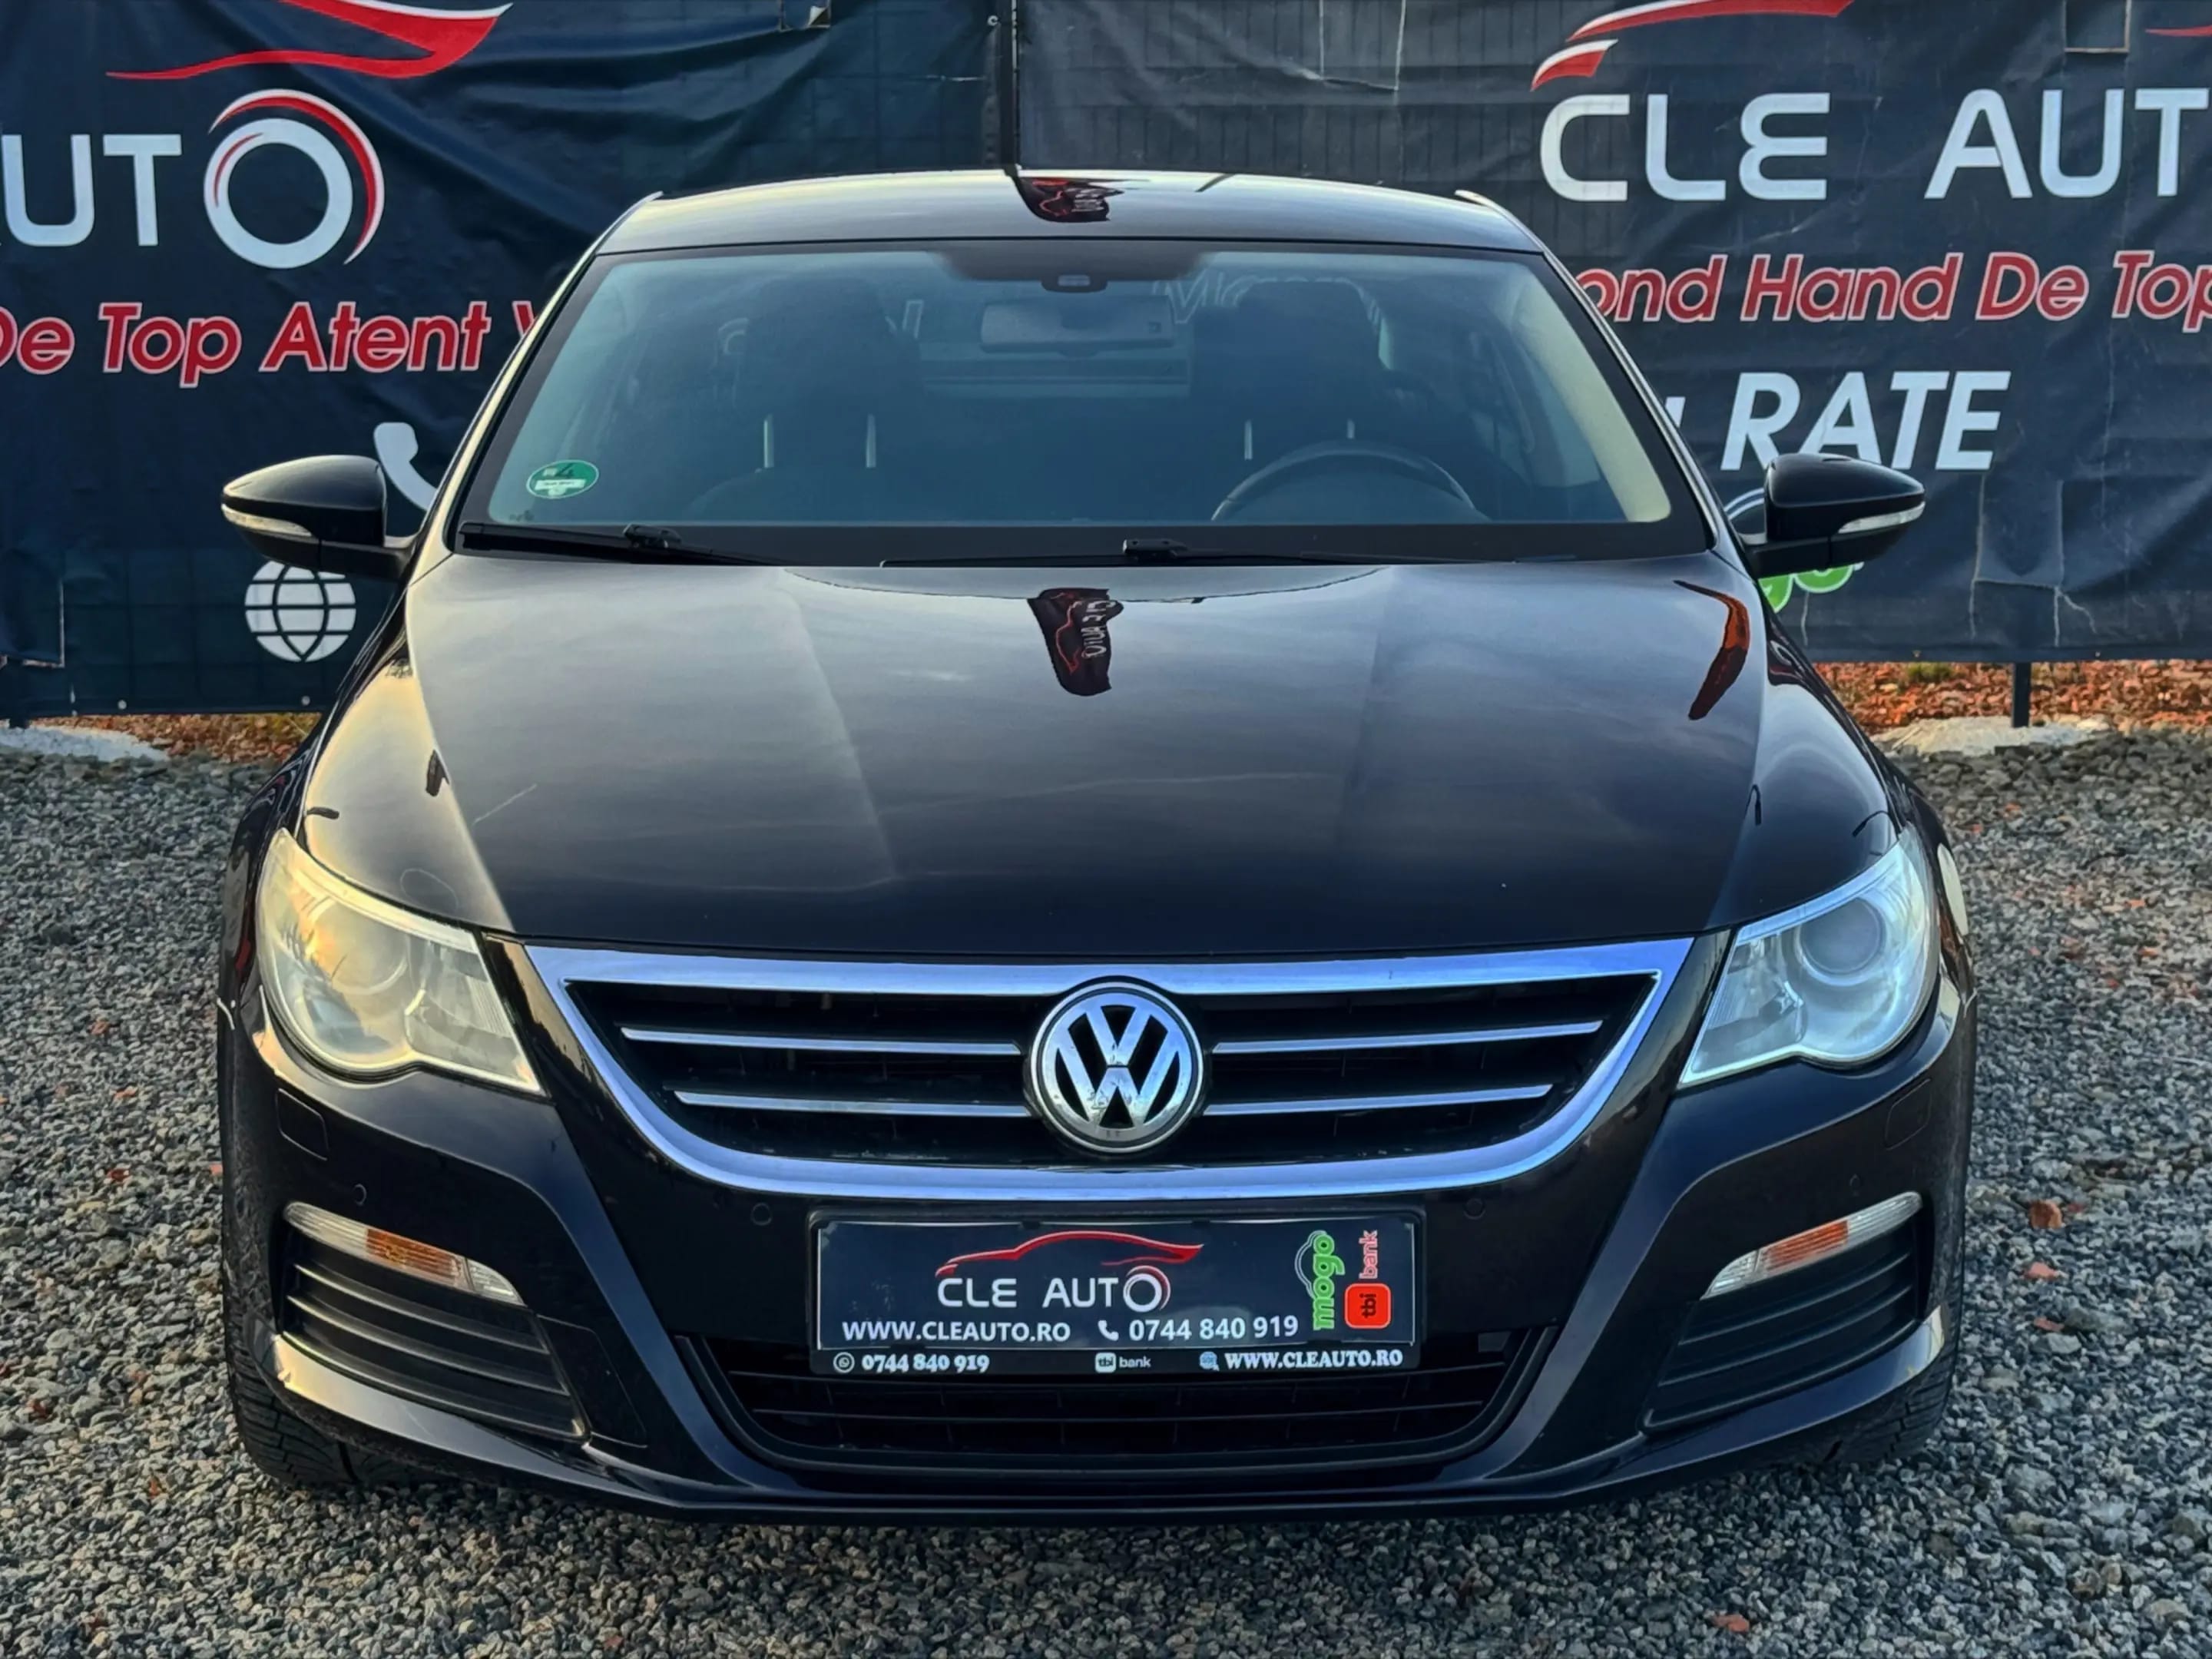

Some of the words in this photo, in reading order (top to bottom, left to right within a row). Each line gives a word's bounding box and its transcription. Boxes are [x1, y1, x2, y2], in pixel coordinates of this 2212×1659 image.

[1540, 92, 1830, 202] CLE
[1740, 253, 1964, 323] Hand
[1975, 252, 2090, 321] De
[0, 306, 75, 375] e
[98, 303, 242, 388] Top
[259, 301, 492, 373] Atent
[1720, 371, 2012, 470] RATE
[1358, 1230, 1379, 1280] bank
[938, 1278, 1017, 1307] CLE
[1042, 1273, 1163, 1313] AUTO
[1313, 1233, 1346, 1331] mogo
[842, 1321, 1071, 1342] WWW.CLEAUTO.RO
[1128, 1319, 1192, 1342] 0744
[1199, 1318, 1246, 1341] 840
[1253, 1315, 1299, 1339] 919
[861, 1354, 909, 1373] 0744
[912, 1354, 950, 1373] 840
[954, 1354, 990, 1373] 919
[1119, 1356, 1151, 1369] bank
[1224, 1349, 1403, 1369] WWW.CLEAUTO.RO
